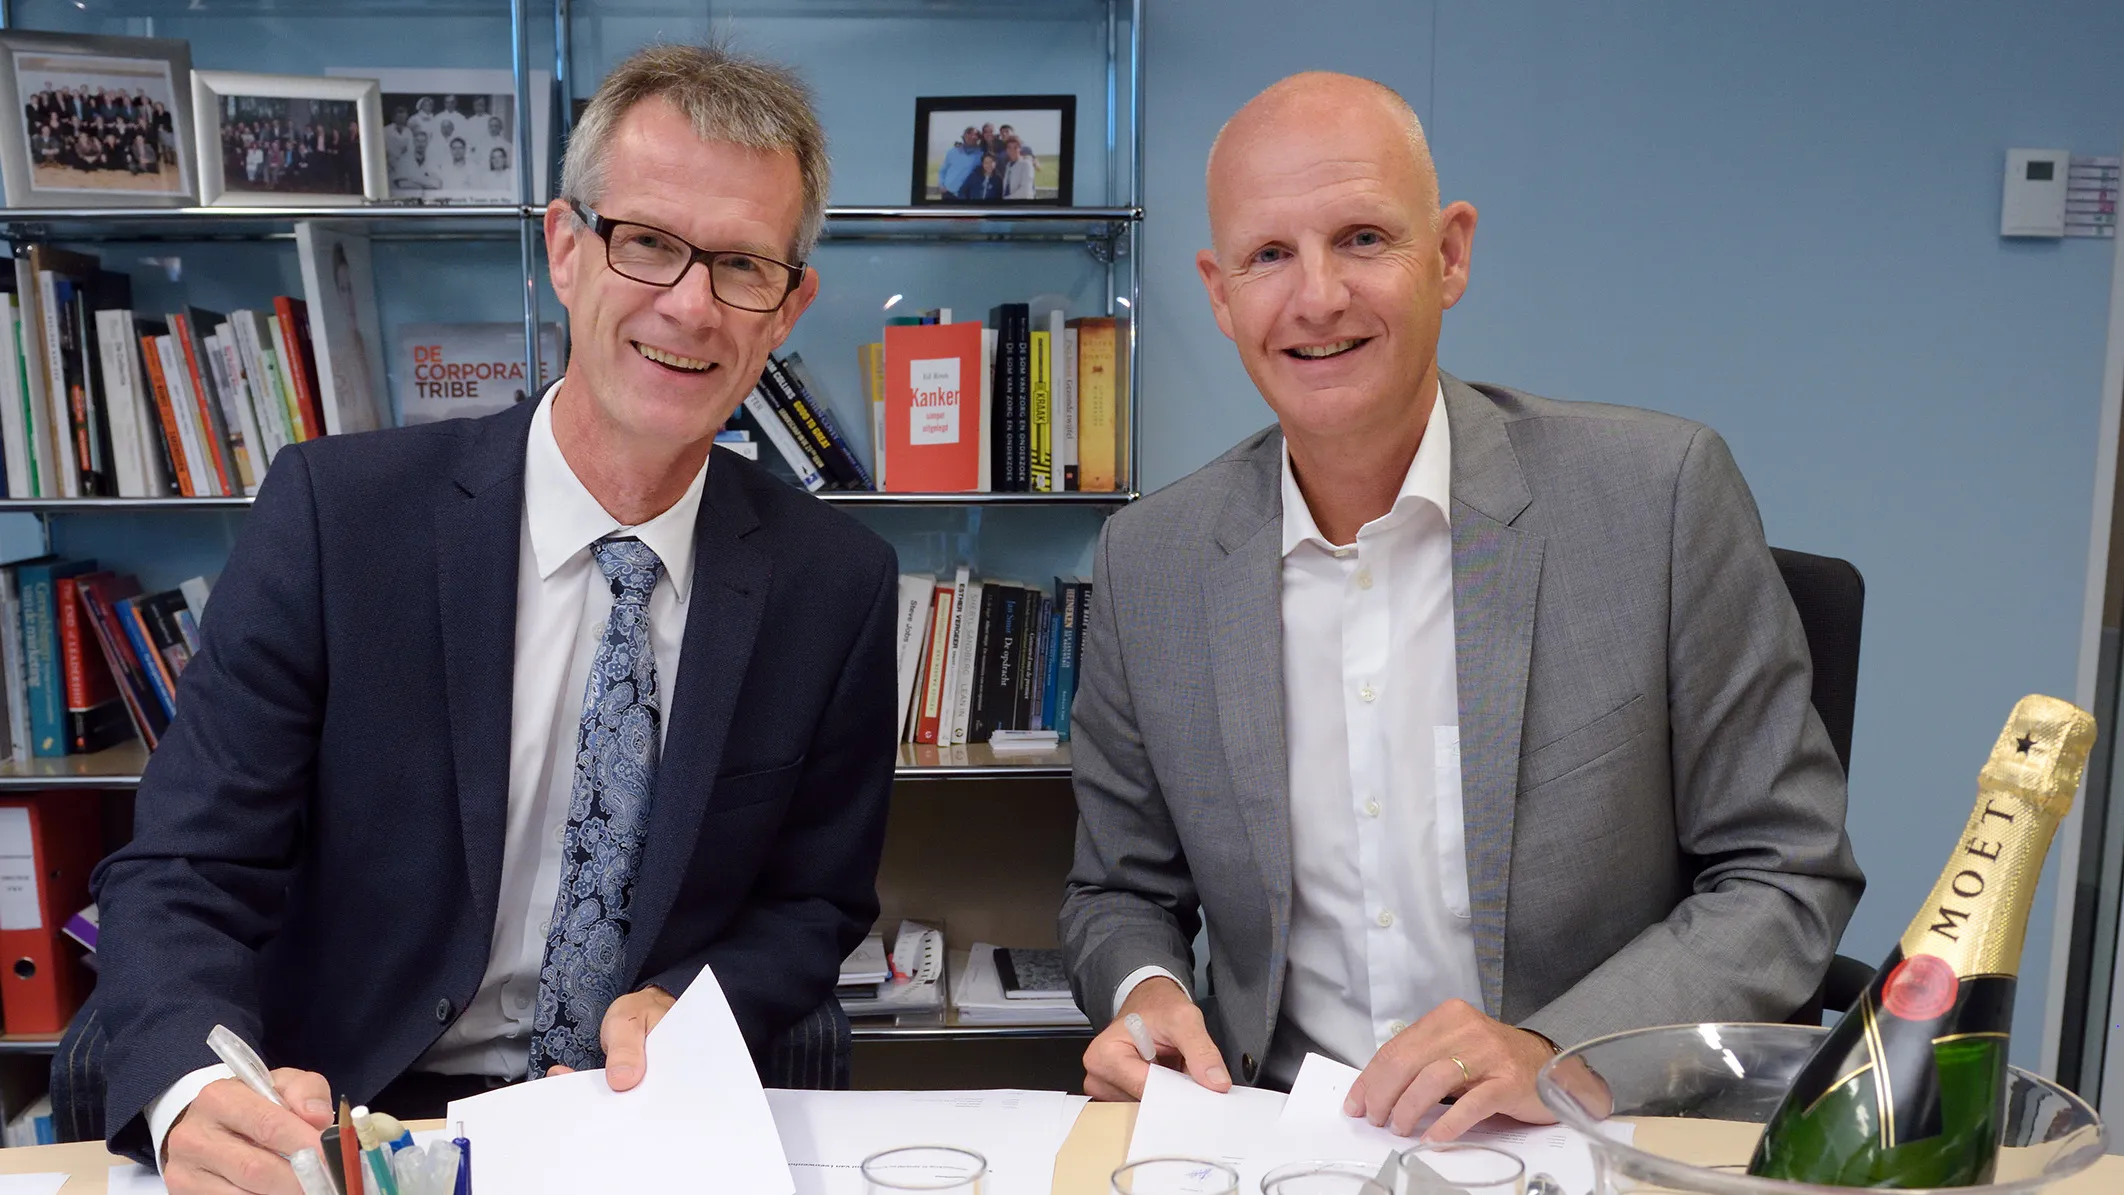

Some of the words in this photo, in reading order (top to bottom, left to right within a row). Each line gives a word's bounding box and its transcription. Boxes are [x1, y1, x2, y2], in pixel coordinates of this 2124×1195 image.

[413, 346, 443, 363] DE
[414, 362, 549, 381] CORPORAE
[415, 381, 479, 398] TRIBE
[910, 386, 960, 408] Kanker
[773, 371, 796, 400] COLLINS
[793, 400, 810, 420] GOOD
[805, 418, 816, 430] TO
[811, 426, 831, 449] GREAT
[1036, 393, 1046, 422] KRAAK
[1007, 420, 1013, 431] EN
[1020, 420, 1026, 431] EN
[957, 583, 965, 613] ESTHER
[1065, 588, 1075, 628] HEINEKEN
[907, 600, 917, 622] Steve
[967, 594, 978, 627] SHERYL
[903, 623, 913, 642] Jobs
[953, 615, 962, 649] VERGEER
[1003, 637, 1013, 648] De
[962, 629, 974, 676] SANDBERG
[1000, 650, 1011, 686] opdracht
[960, 684, 968, 707] LEAN
[959, 709, 965, 718] IN
[1929, 799, 2014, 943] MOËT
